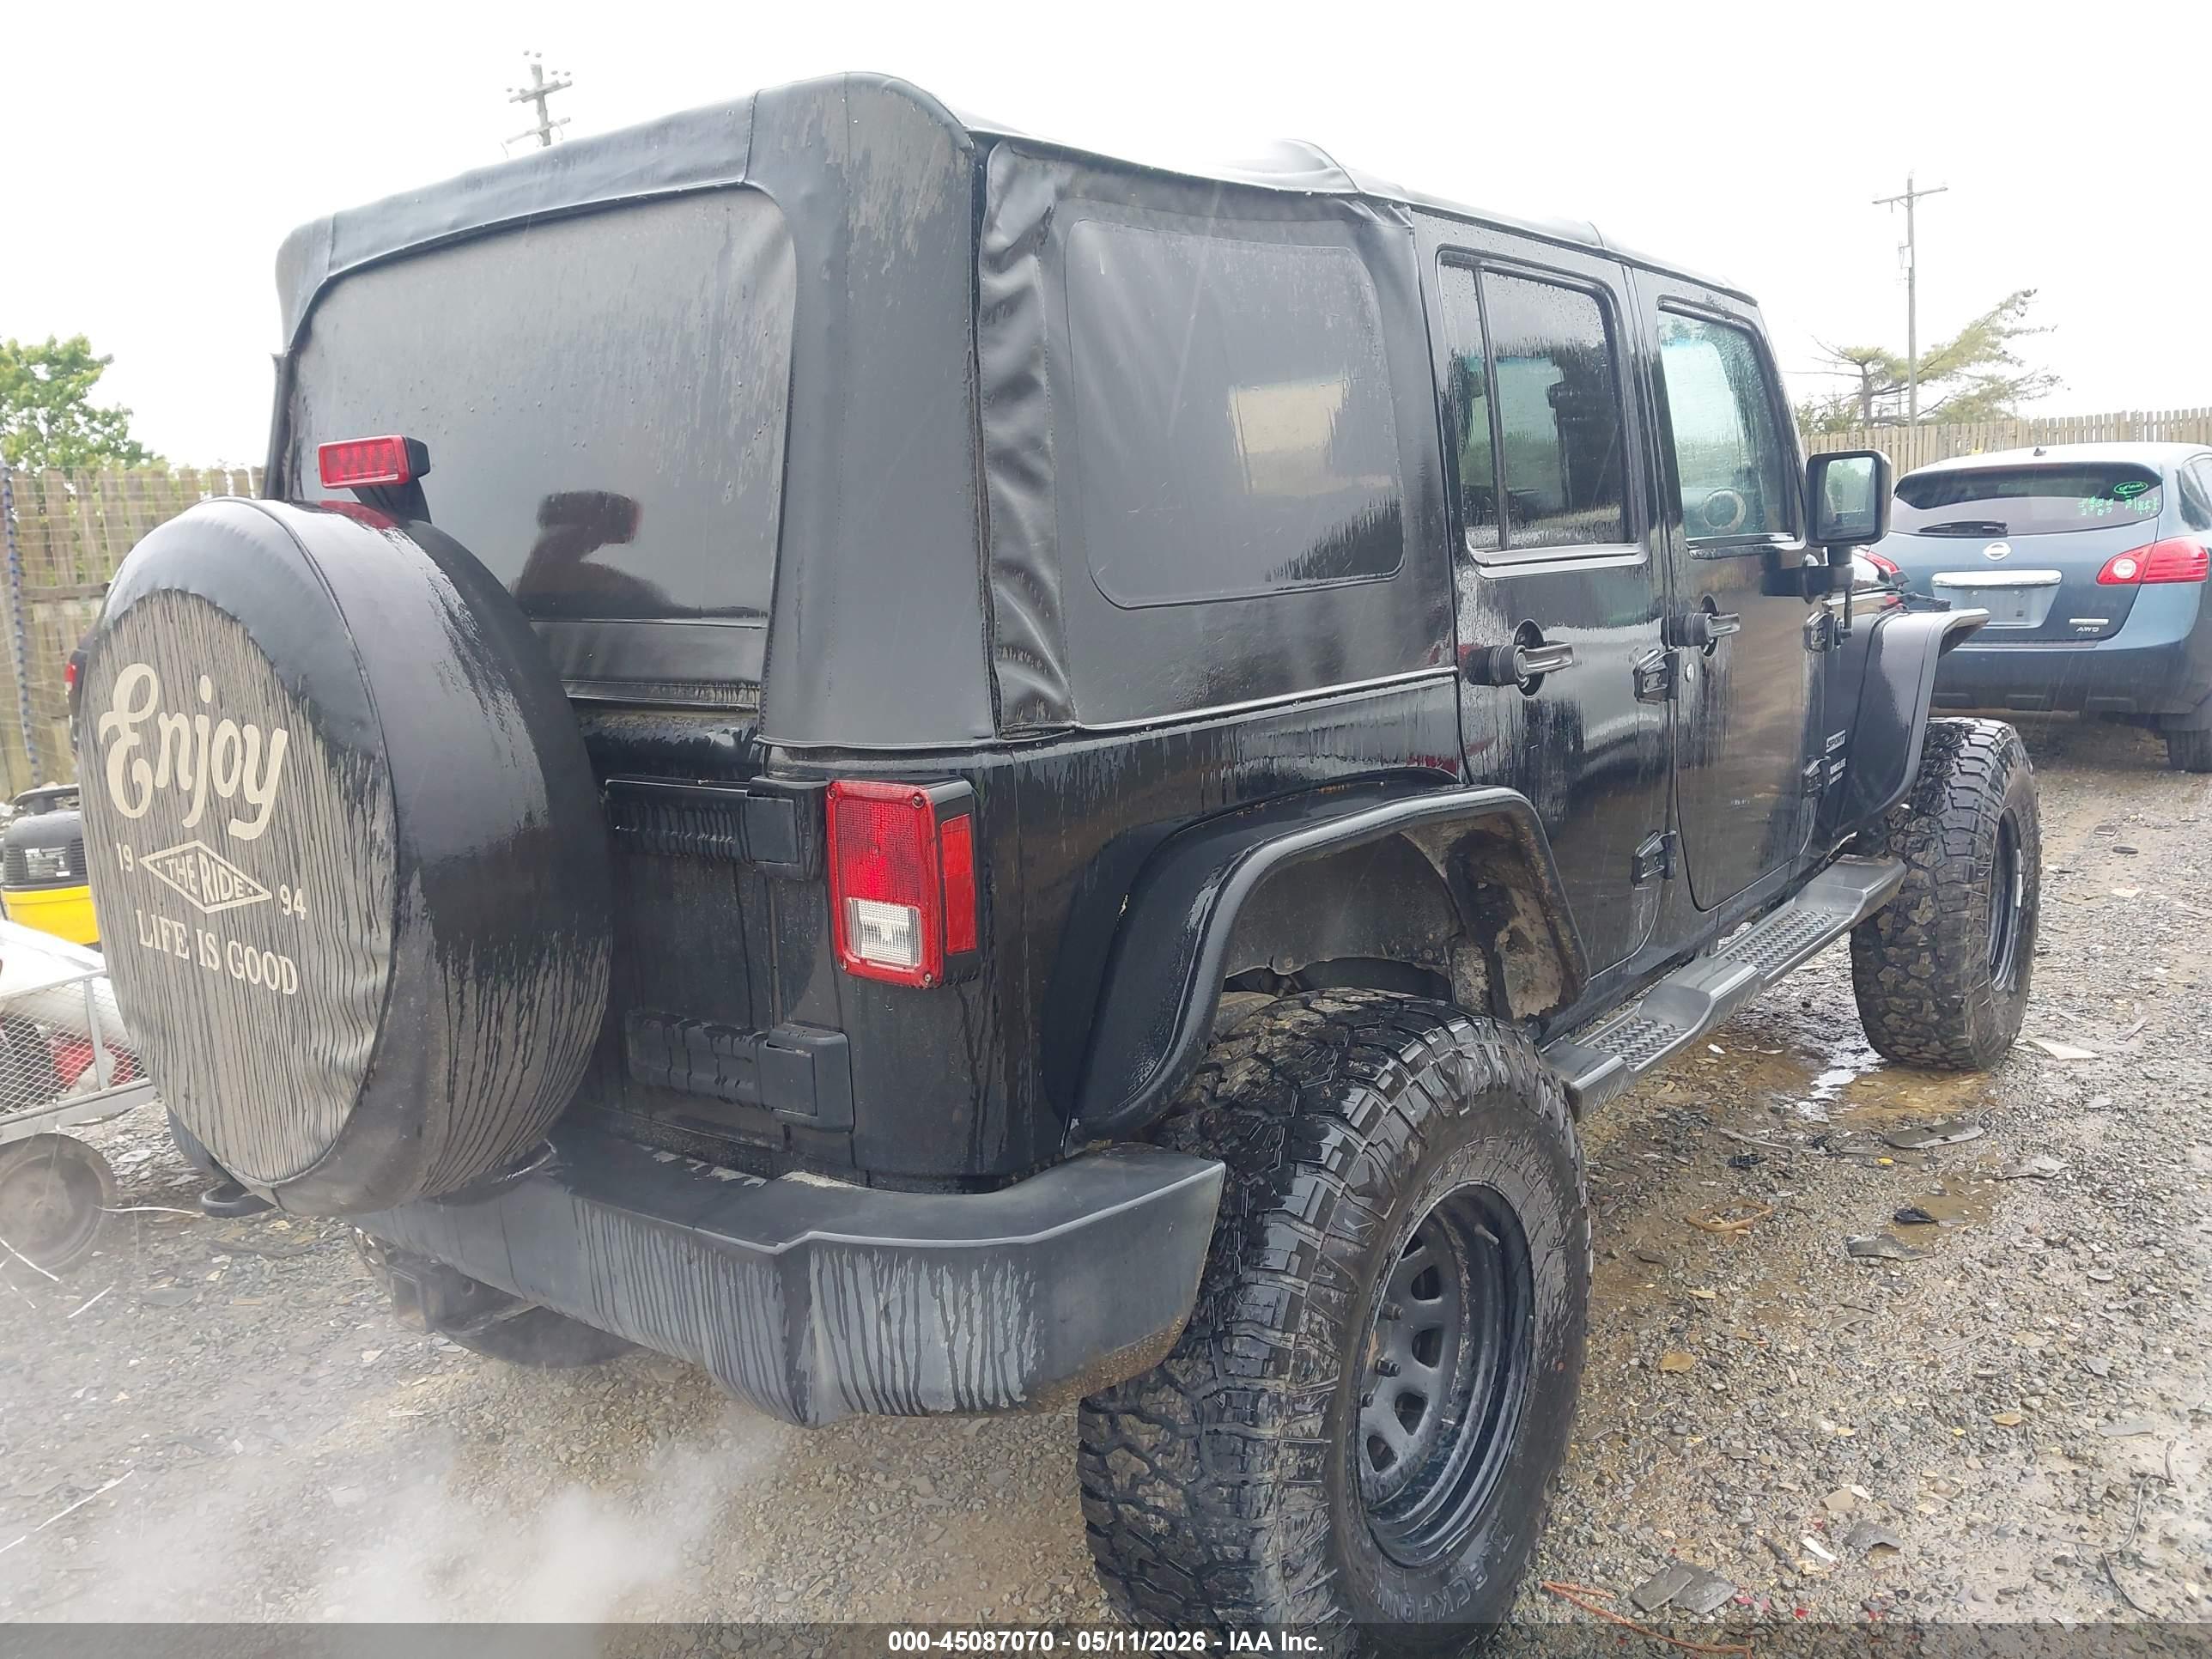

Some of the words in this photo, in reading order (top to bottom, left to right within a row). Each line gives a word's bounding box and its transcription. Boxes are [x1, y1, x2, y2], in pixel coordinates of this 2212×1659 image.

[99, 663, 289, 841] Enjoy
[1826, 732, 1845, 750] SPORT
[115, 842, 133, 872] 19
[165, 857, 198, 896] THE
[200, 852, 245, 902] RIDE
[279, 884, 307, 921] 94
[136, 908, 190, 961] LIFE
[196, 928, 221, 972] IS
[227, 939, 299, 996] GOOD
